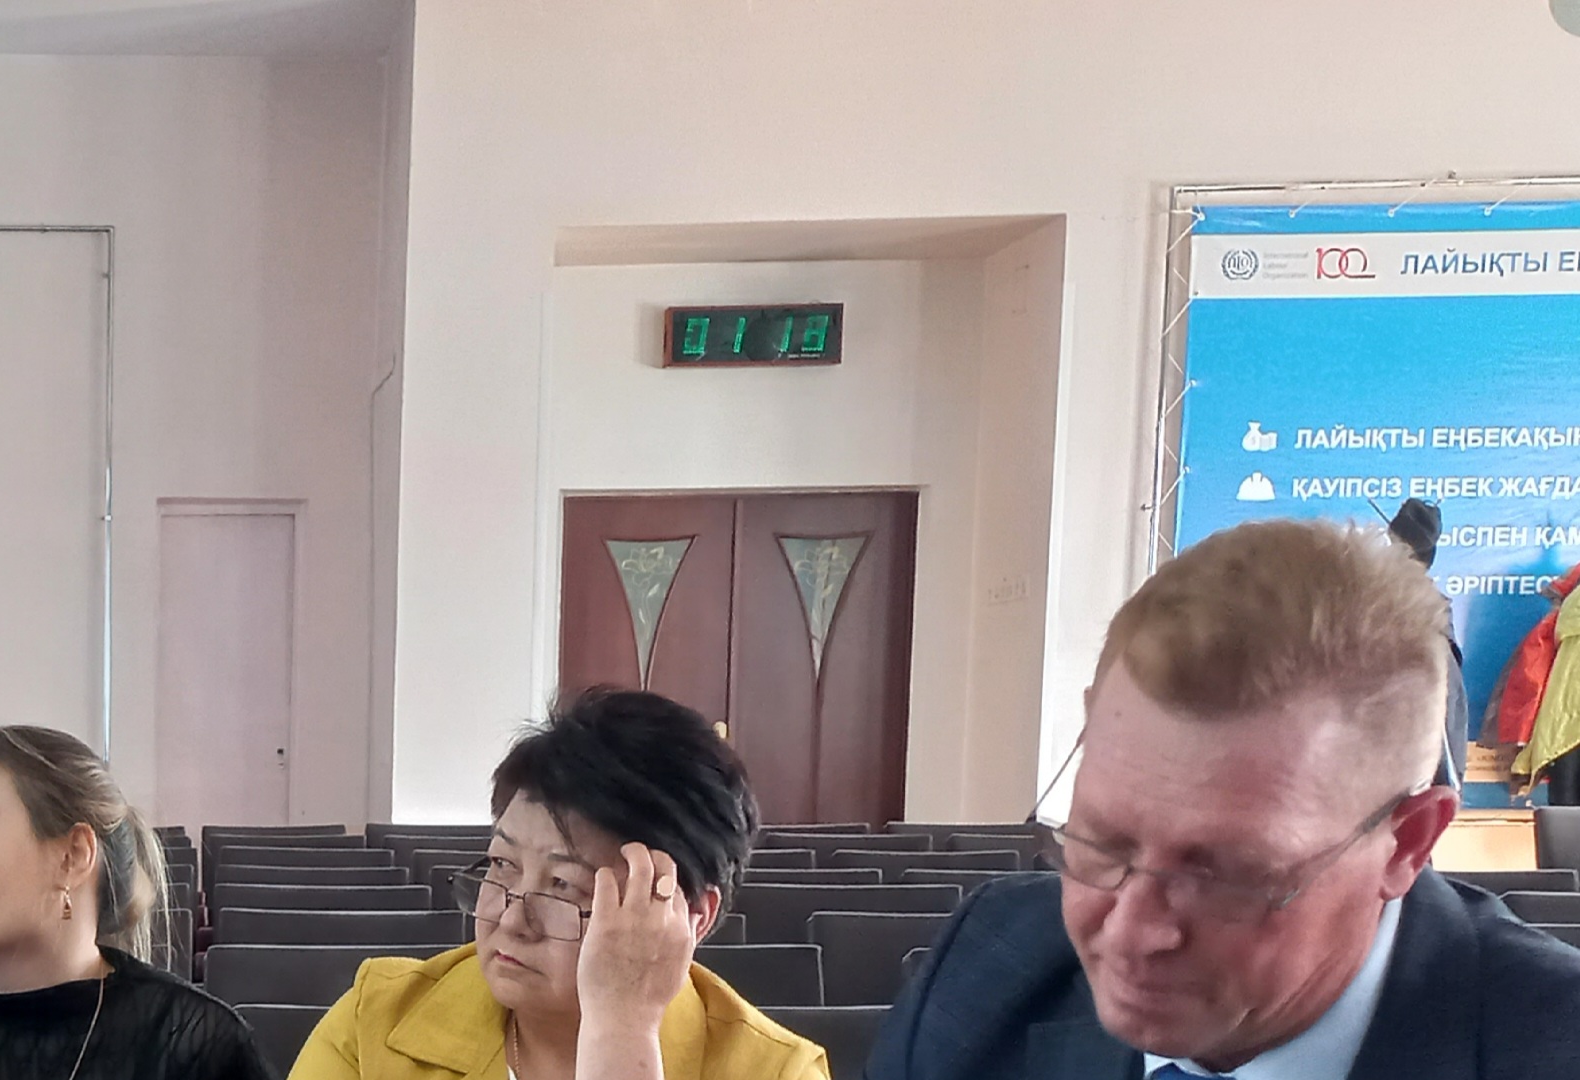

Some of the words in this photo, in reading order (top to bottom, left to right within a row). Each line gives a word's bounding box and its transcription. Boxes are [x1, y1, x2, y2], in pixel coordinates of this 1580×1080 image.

[1400, 248, 1548, 277] ЛАЙЫҚТЫ
[1558, 251, 1580, 273] Е
[1294, 424, 1424, 452] ЛАЙЫҚТЫ
[1292, 477, 1402, 500] ҚАУІПСІЗ
[1409, 477, 1493, 499] ЕҢБЕК
[1436, 526, 1528, 547] ЫСПЕН
[1446, 575, 1558, 595] ӘРІПТЕС
